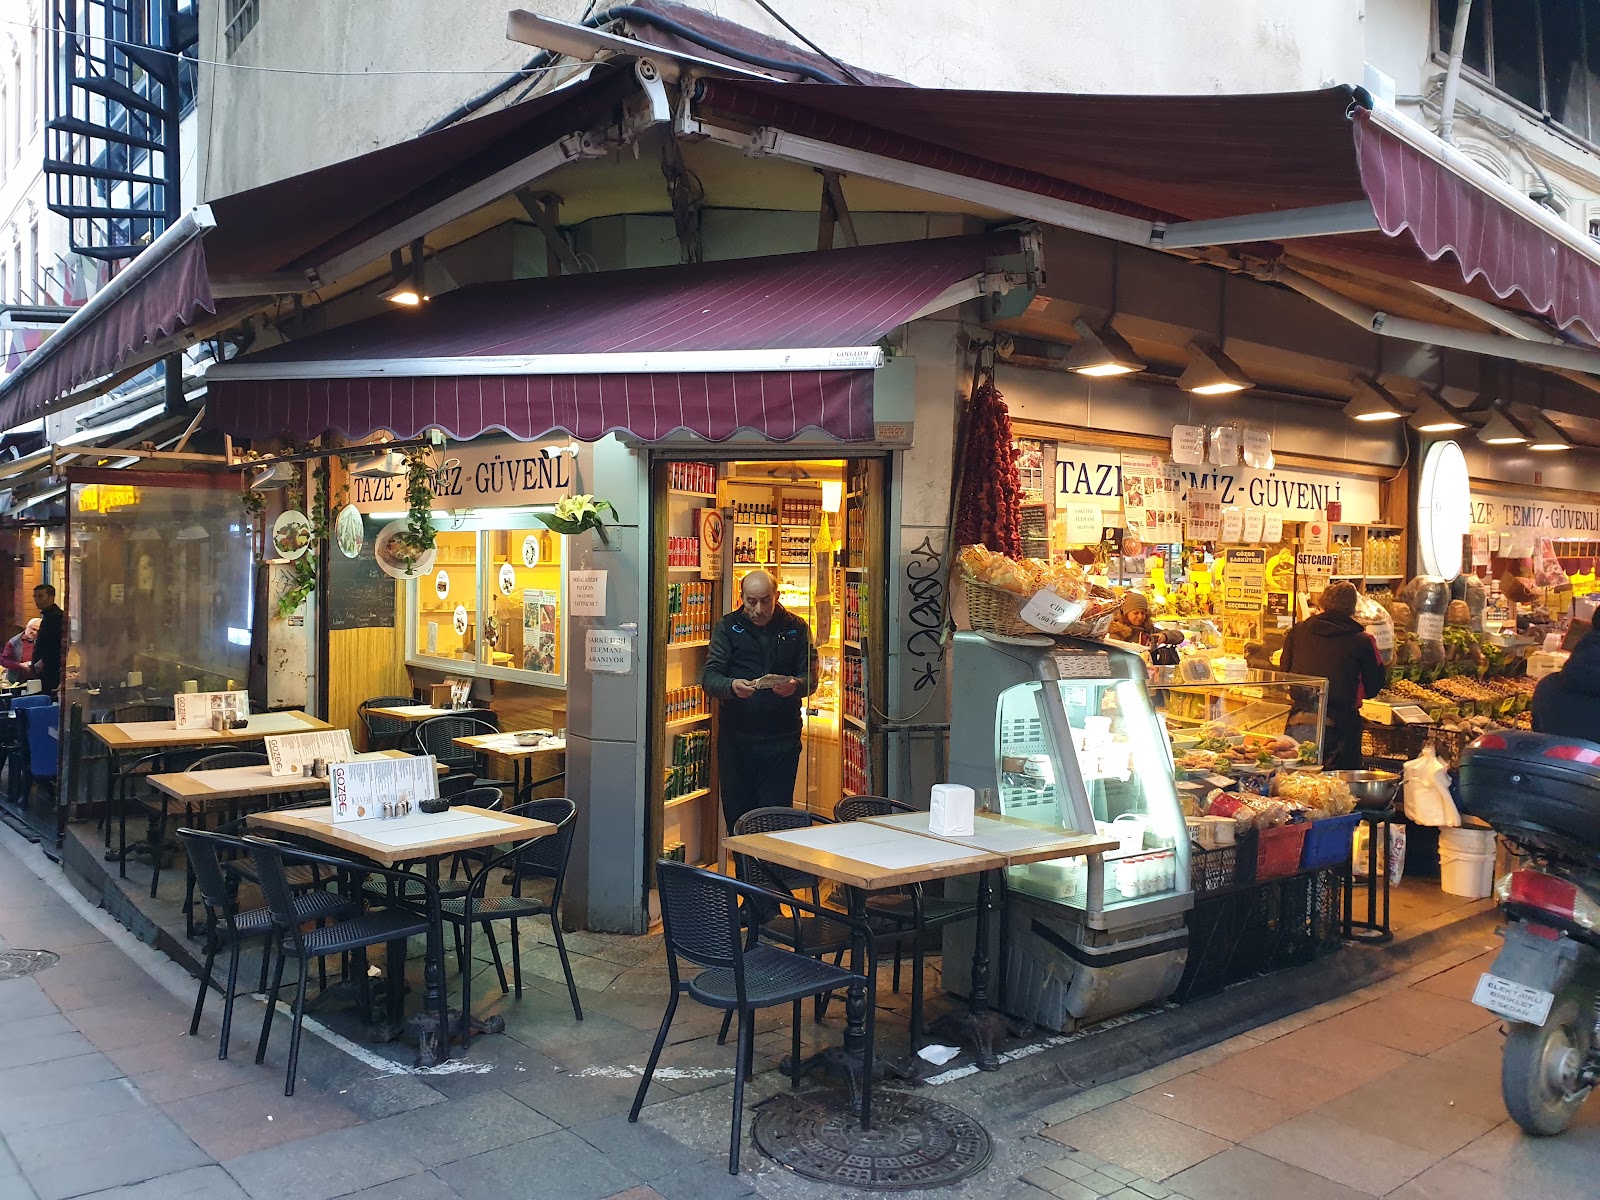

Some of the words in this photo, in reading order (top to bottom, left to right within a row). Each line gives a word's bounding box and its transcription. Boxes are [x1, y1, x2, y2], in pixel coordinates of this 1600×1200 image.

[353, 477, 394, 503] TAZE
[1469, 501, 1495, 526] AZE
[1503, 502, 1544, 528] TEMİZ
[1550, 504, 1600, 532] GÜVENLİ
[1298, 554, 1333, 566] SETCARD
